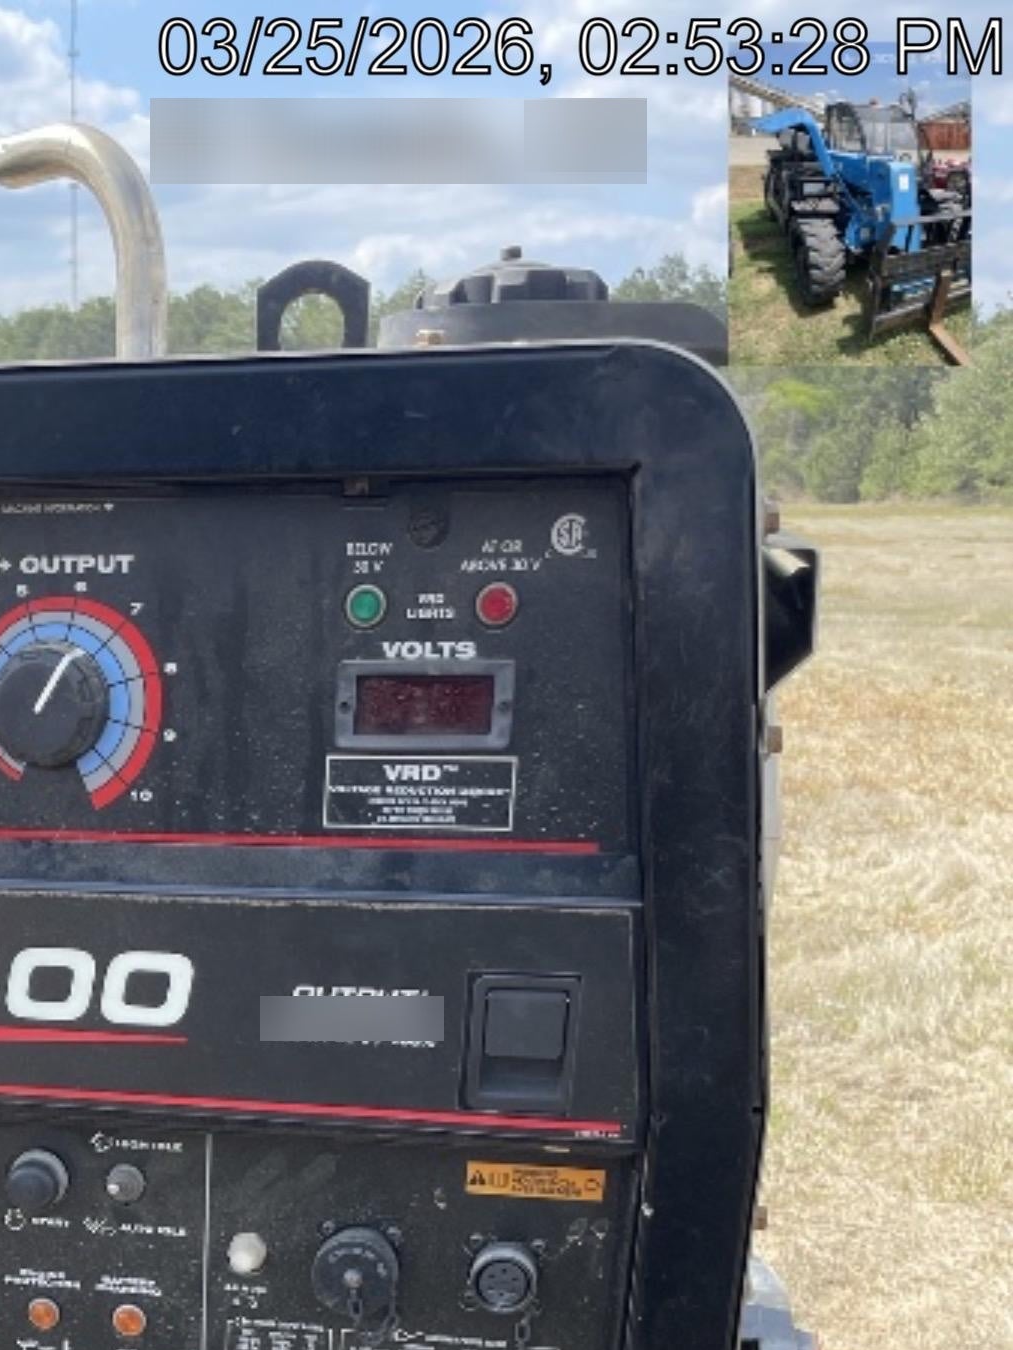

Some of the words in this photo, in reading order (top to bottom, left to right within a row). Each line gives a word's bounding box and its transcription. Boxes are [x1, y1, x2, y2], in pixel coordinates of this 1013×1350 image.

[346, 542, 393, 556] BELOW
[19, 554, 135, 574] OUTPUT
[16, 584, 29, 598] 5
[130, 602, 144, 616] 7
[406, 607, 455, 619] LIGHTS
[381, 641, 477, 659] VOLTS
[163, 728, 177, 742] 9
[131, 789, 153, 802] 10
